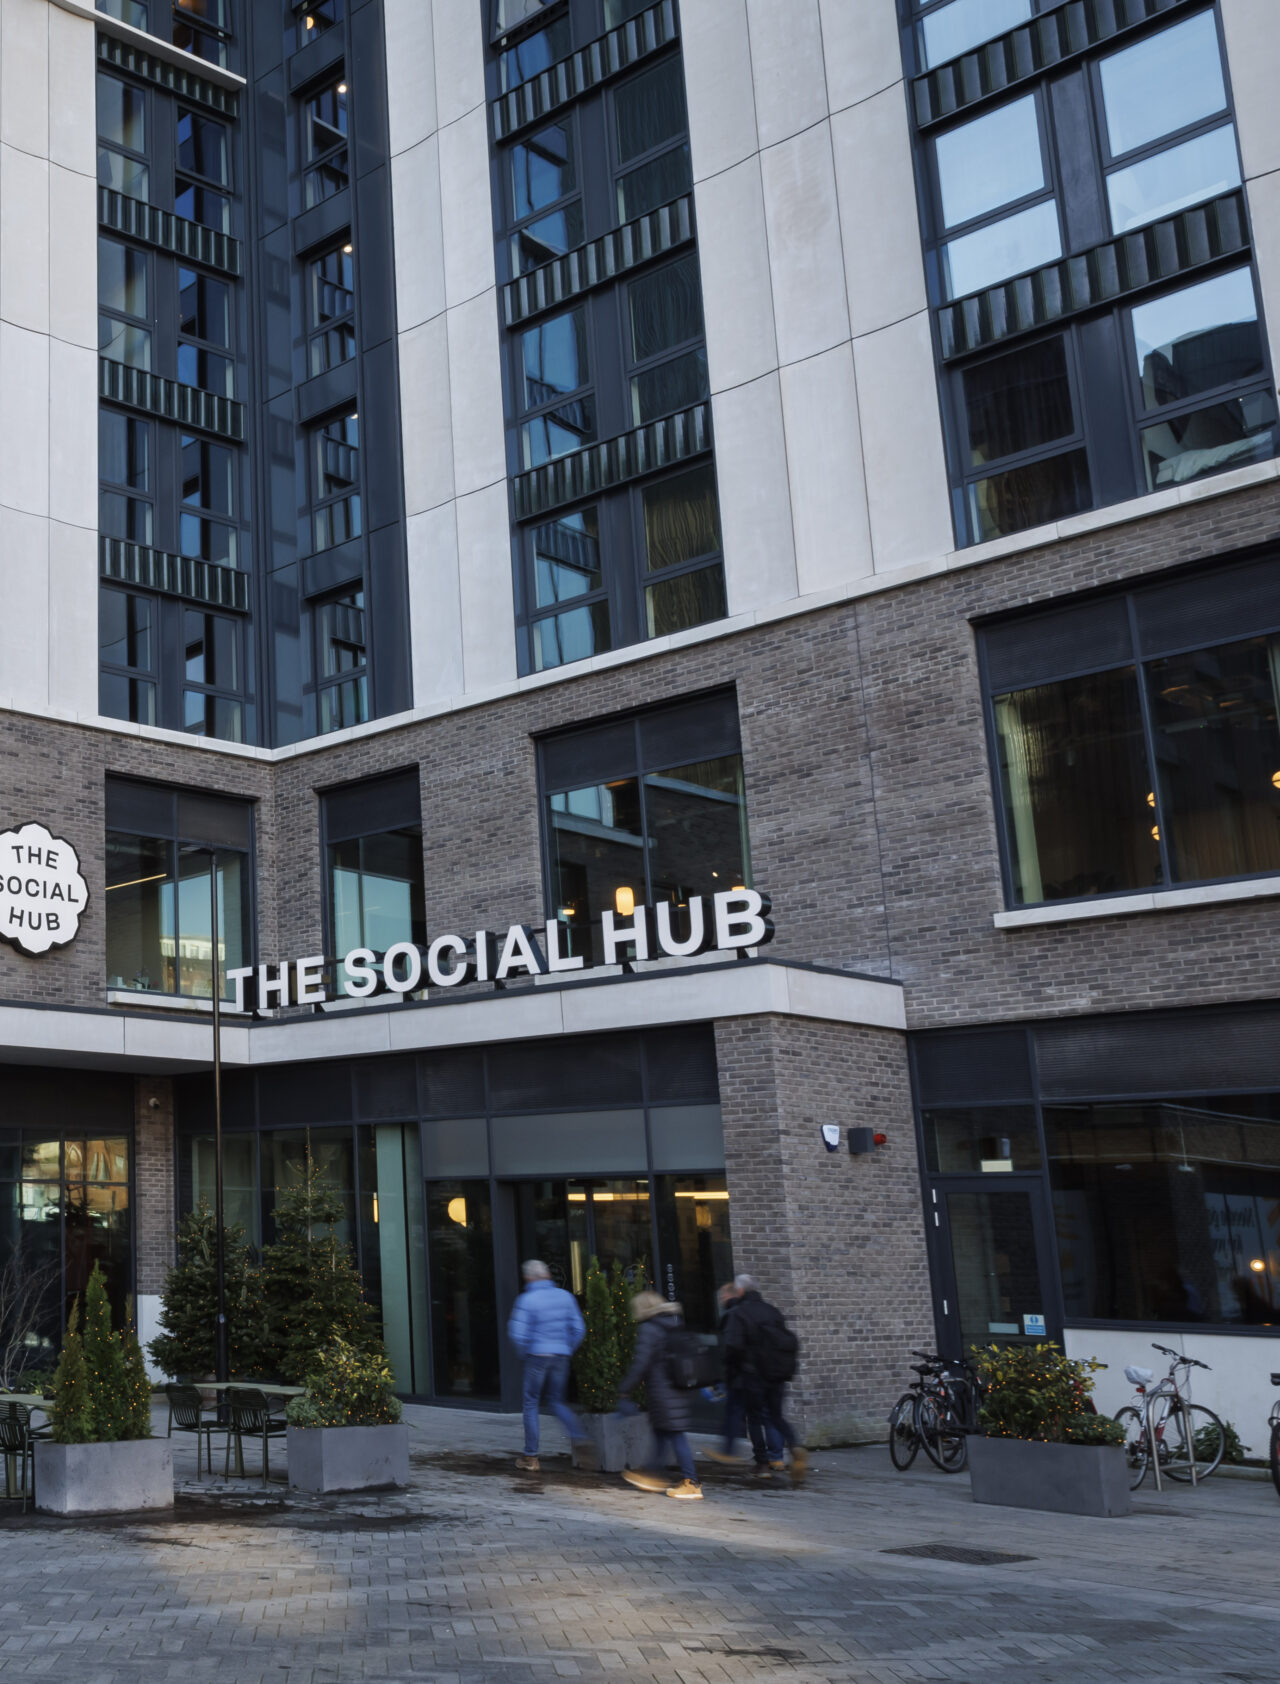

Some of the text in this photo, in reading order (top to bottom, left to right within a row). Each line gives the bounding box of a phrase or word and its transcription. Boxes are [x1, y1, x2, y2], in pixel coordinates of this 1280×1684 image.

[11, 845, 59, 870] THE
[8, 906, 61, 931] HUB
[226, 888, 770, 1012] THE SOCIAL HUB
